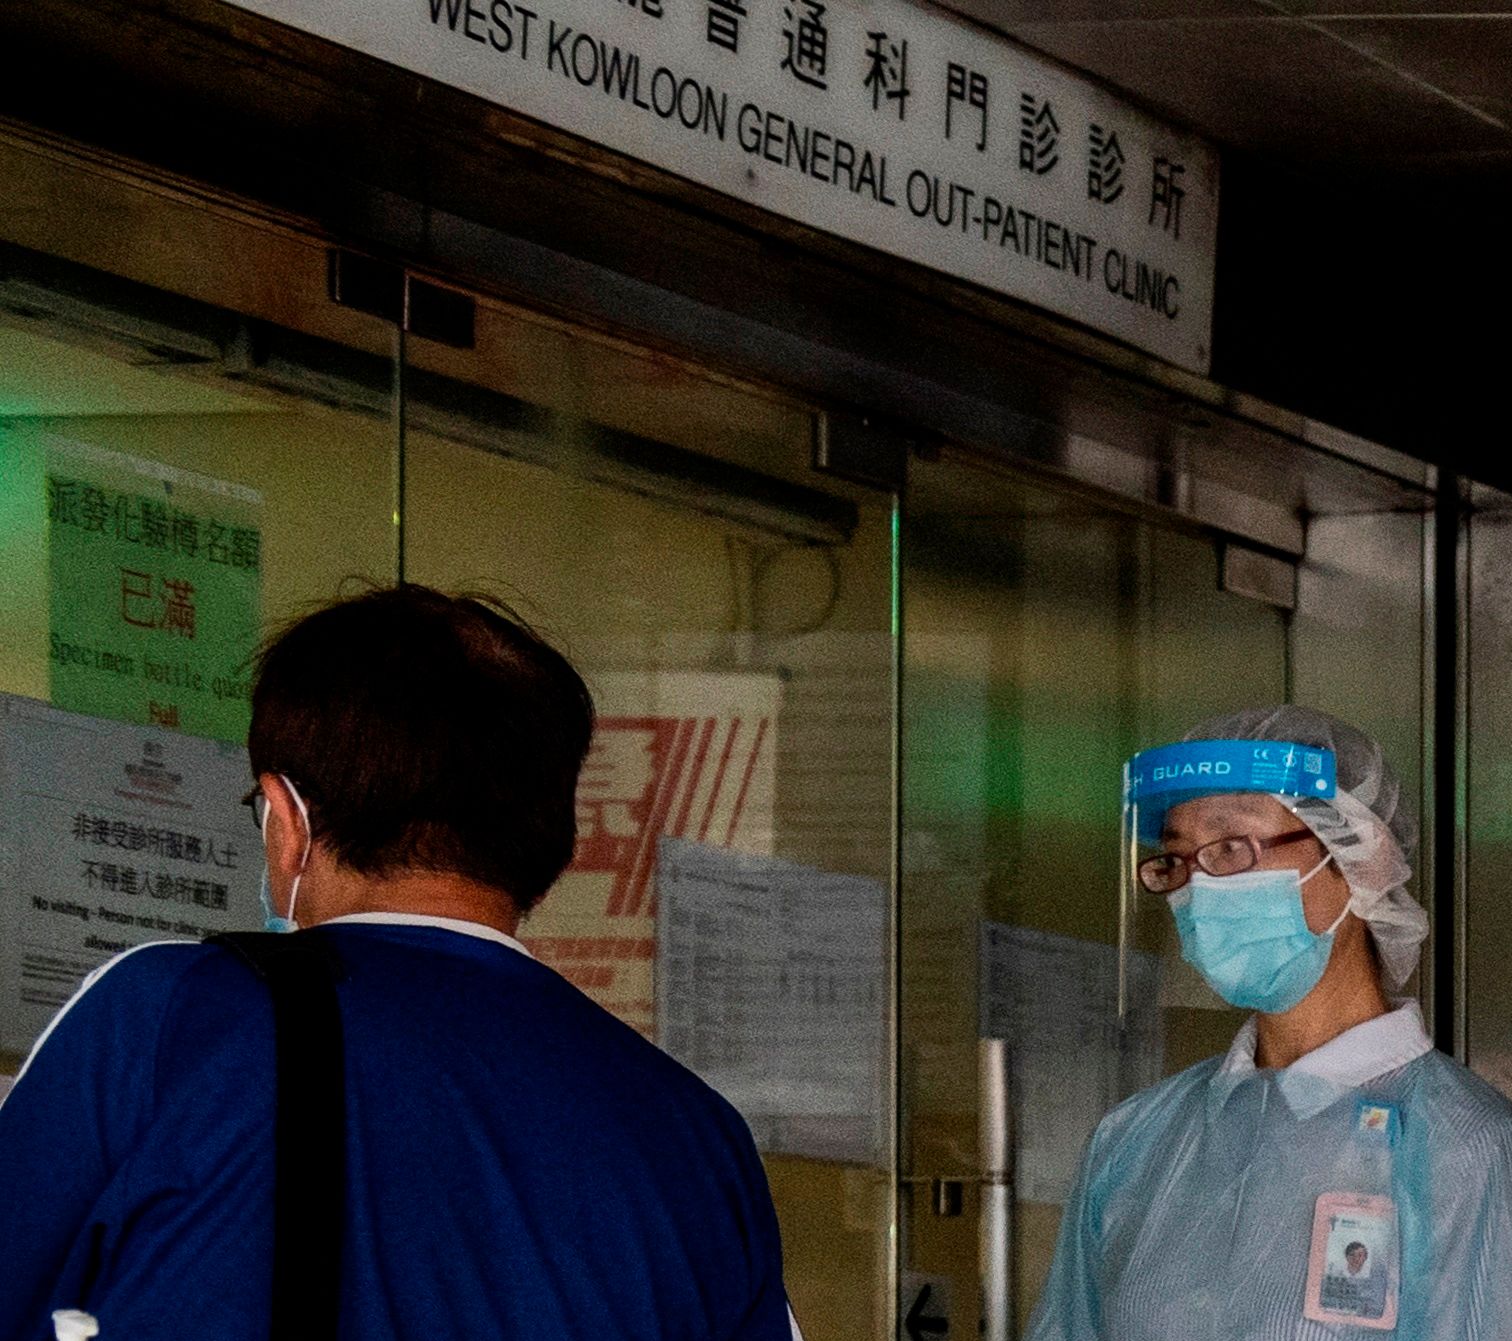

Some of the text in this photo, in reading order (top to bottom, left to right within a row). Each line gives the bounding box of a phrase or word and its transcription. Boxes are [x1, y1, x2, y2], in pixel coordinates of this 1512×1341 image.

[428, 0, 1180, 320] WEST KOWLOON GENERAL OUT-PATIENT CLINIC
[121, 566, 196, 640] 已滿
[50, 632, 134, 675] Specimen
[144, 654, 202, 692] bottle
[1152, 761, 1231, 782] GUARD
[32, 895, 48, 911] No
[50, 899, 90, 922] visiting
[98, 905, 134, 926] Person
